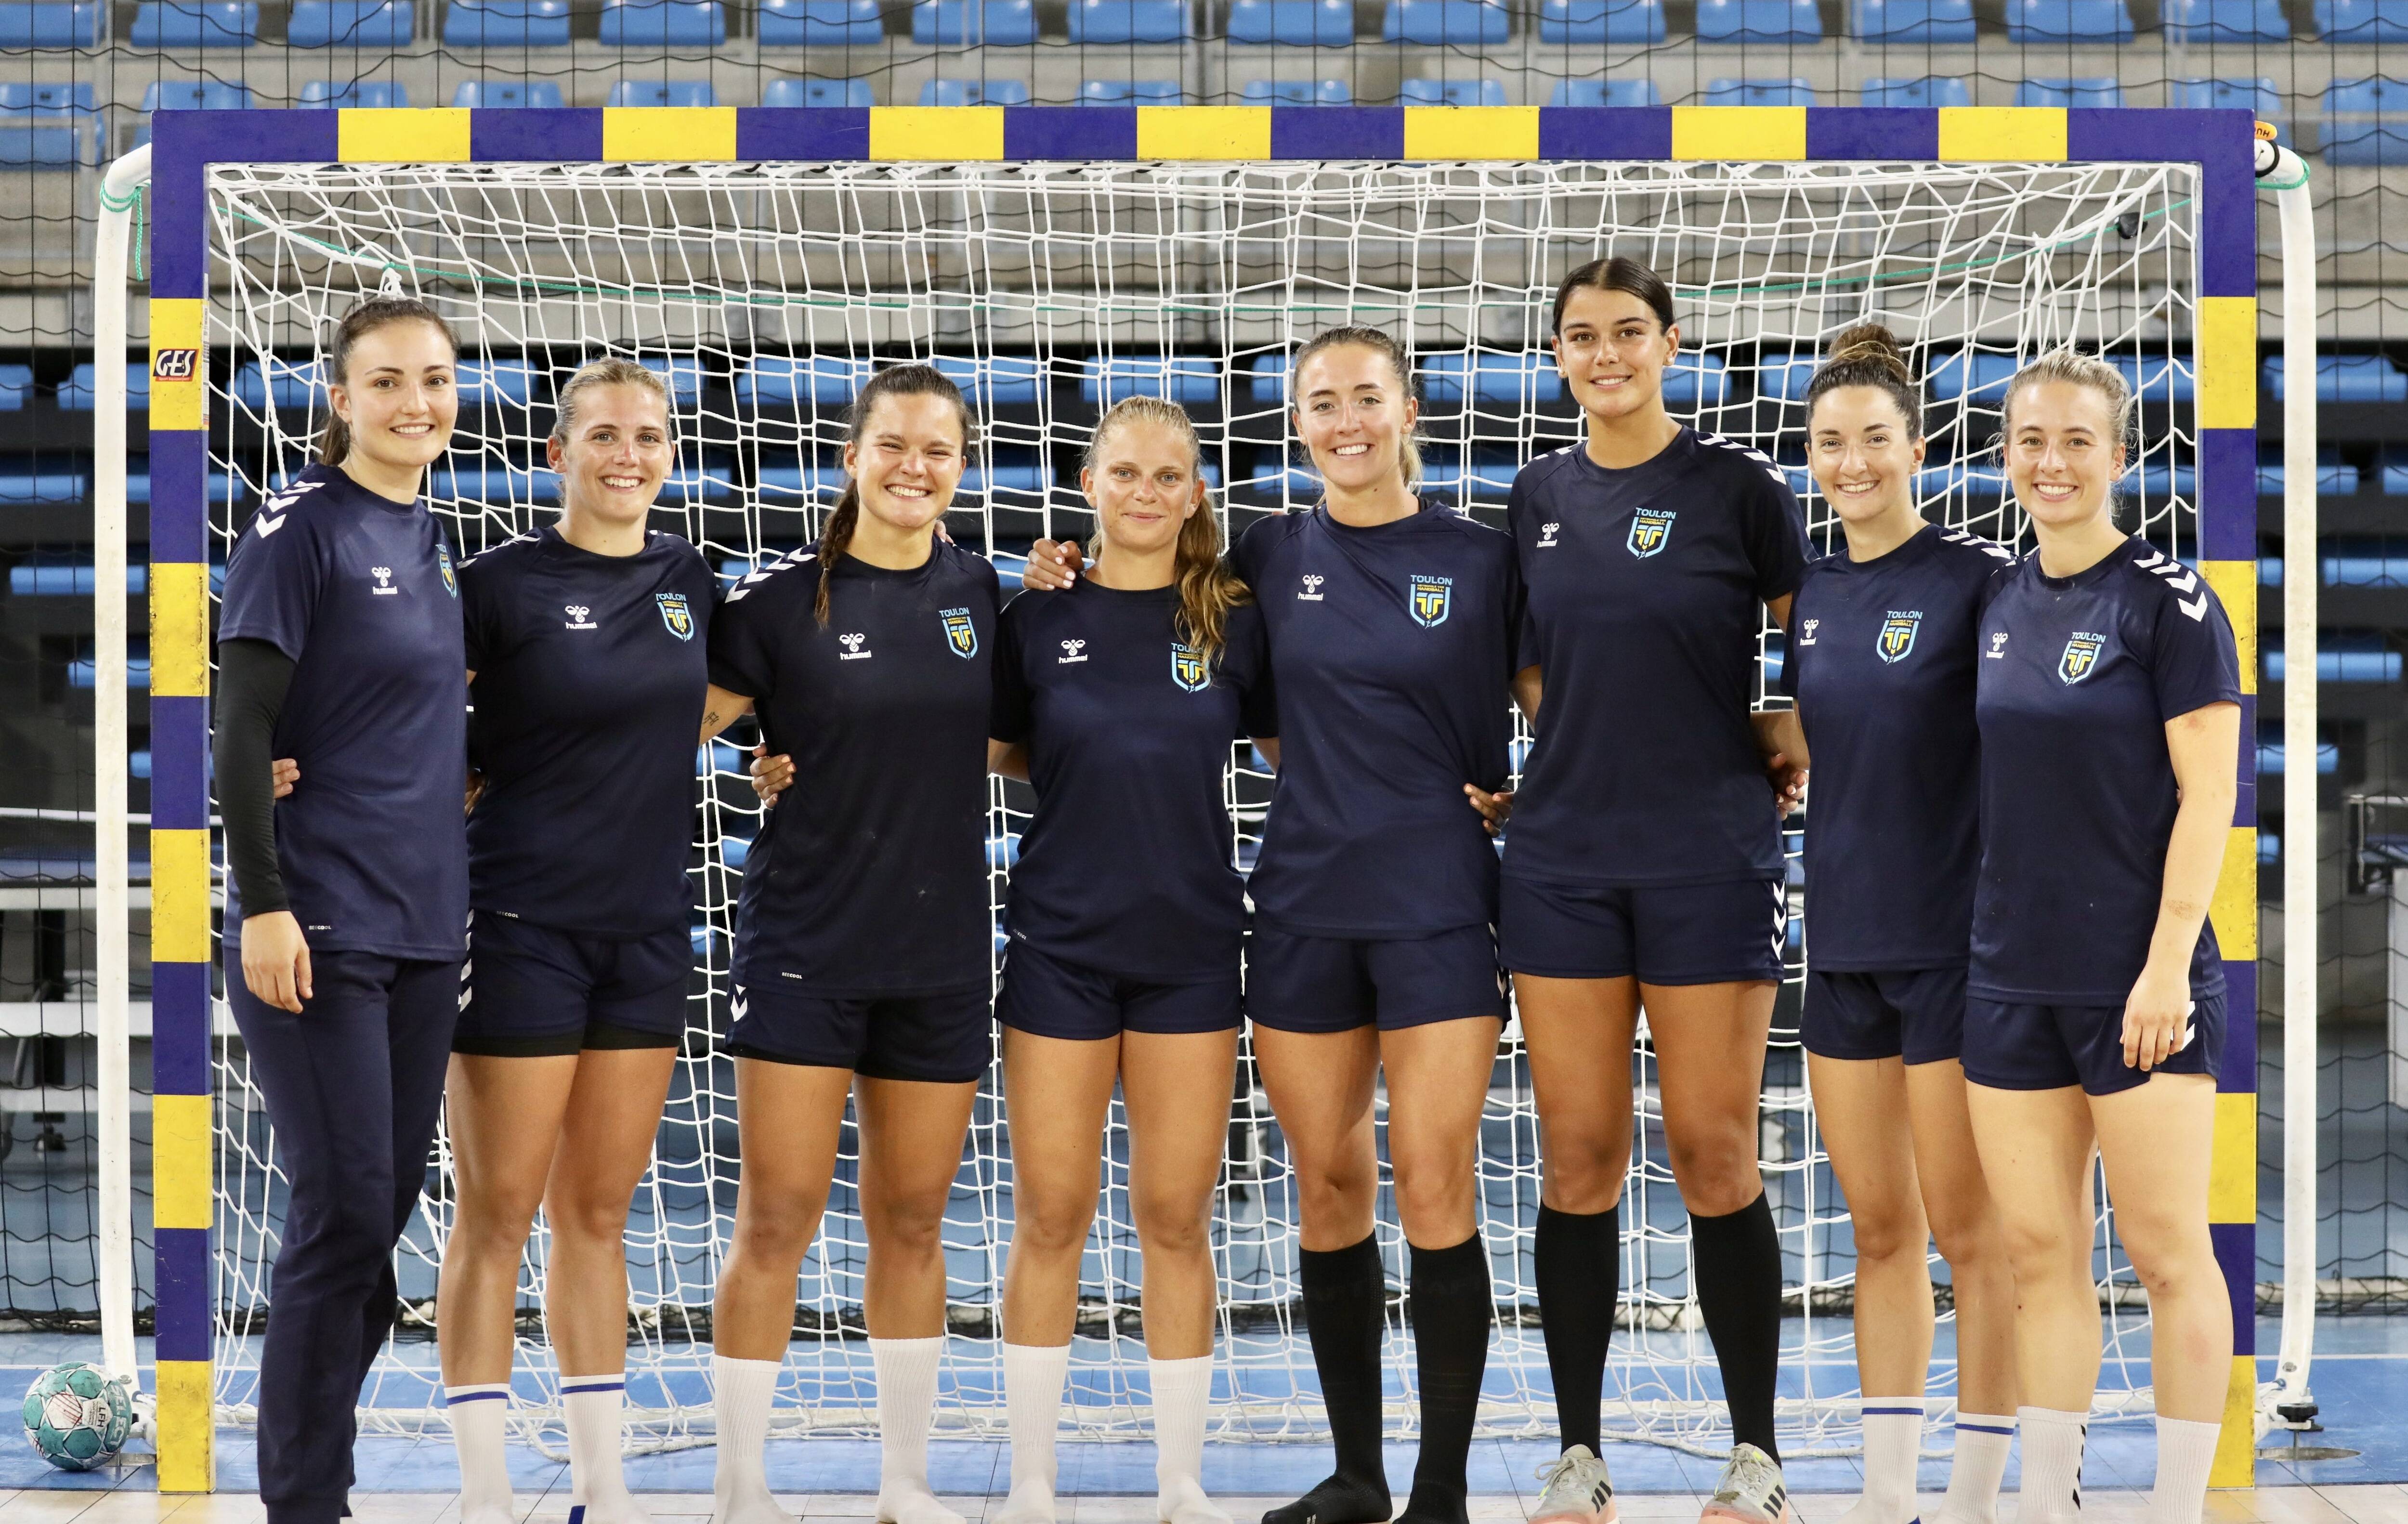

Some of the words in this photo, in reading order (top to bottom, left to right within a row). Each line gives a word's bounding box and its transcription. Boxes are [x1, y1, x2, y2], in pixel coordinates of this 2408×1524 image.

[2256, 128, 2270, 137] HU
[156, 350, 196, 376] GES
[1636, 507, 1676, 519] TOULON
[1410, 575, 1453, 585] TOULON
[373, 586, 398, 595] hummel
[655, 592, 686, 601] TOULON
[1298, 592, 1323, 601] hummel
[939, 607, 969, 617] TOULON
[1887, 610, 1923, 619] TOULON
[2071, 632, 2107, 643] TOULON
[1171, 643, 1204, 654] TOUO
[840, 650, 871, 660] hummel
[1059, 655, 1087, 663] hummel
[97, 1407, 106, 1427] LFH
[109, 1385, 127, 1446] SELECT
